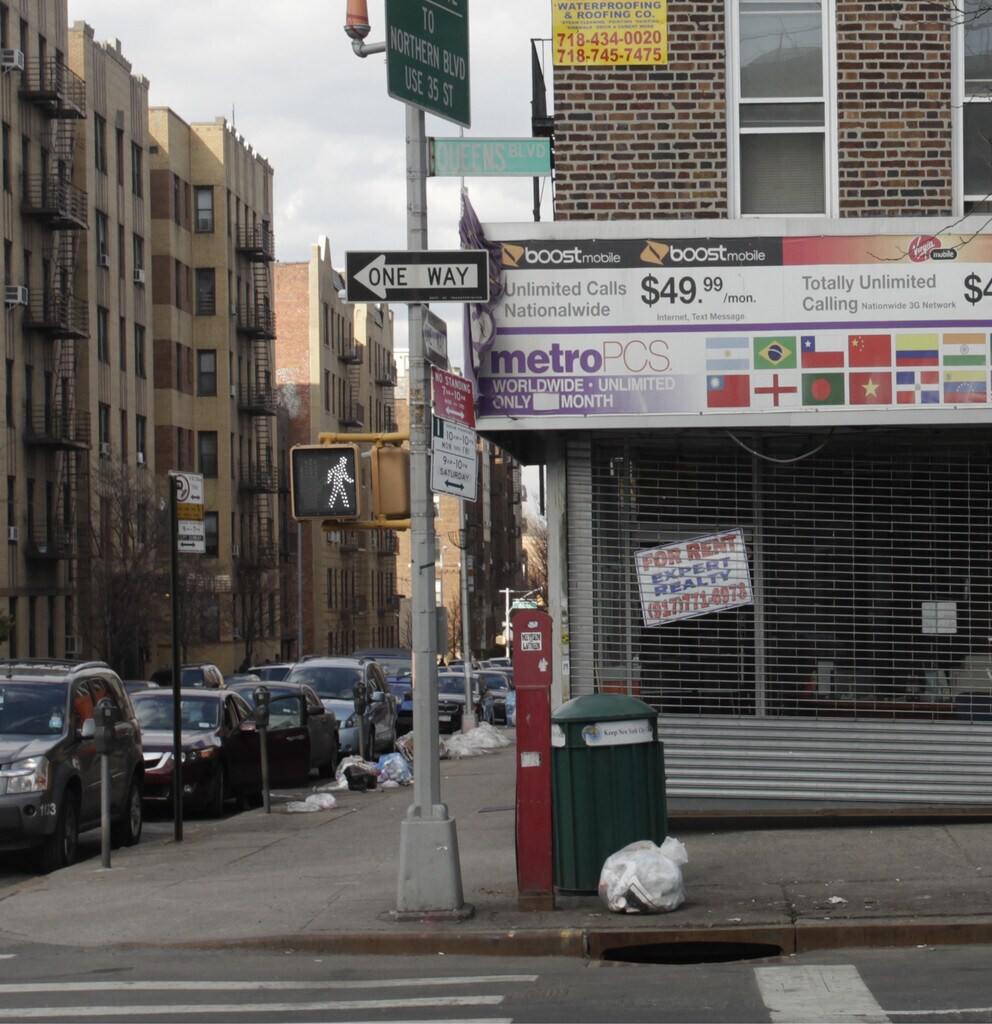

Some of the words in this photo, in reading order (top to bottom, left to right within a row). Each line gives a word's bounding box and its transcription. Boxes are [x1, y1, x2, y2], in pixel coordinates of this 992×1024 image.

[558, 2, 661, 10] WATERPROOFING
[577, 11, 630, 19] ROOFING
[635, 10, 655, 18] CO.
[422, 7, 434, 34] TO
[557, 30, 661, 47] 718-434-0020
[391, 26, 439, 69] NORTHERN
[443, 49, 465, 80] BLVD
[557, 48, 662, 63] 718-745-7475
[405, 66, 423, 95] USE
[427, 76, 439, 101] 35
[443, 83, 453, 108] ST
[436, 143, 507, 171] QUEENS
[509, 143, 545, 158] BLVD
[369, 267, 408, 286] ONE
[427, 267, 469, 286] WAY
[802, 275, 855, 293] Totally
[859, 274, 937, 290] Unlimited
[505, 281, 582, 297] Unlimited
[586, 281, 627, 296] Calls
[640, 273, 723, 307] $49.99
[723, 291, 757, 304] /mon.
[505, 302, 610, 318] Nationalwide
[802, 296, 858, 314] Calling
[861, 302, 907, 310] Nationwide
[909, 301, 920, 310] 3G
[922, 300, 957, 310] Network
[657, 313, 691, 322] Internet,
[692, 312, 708, 321] Text
[709, 312, 745, 322] Message
[445, 376, 471, 394] STANDING
[493, 379, 584, 393] WORLDWIDE
[598, 377, 675, 392] UNLIMITED
[493, 394, 531, 409] ONLY
[561, 394, 613, 408] MONTH
[440, 467, 470, 481] SATURDAY
[642, 548, 682, 571] FOR
[686, 534, 736, 561] RENT
[652, 557, 730, 584] EXPERT
[655, 569, 731, 597] REALTY
